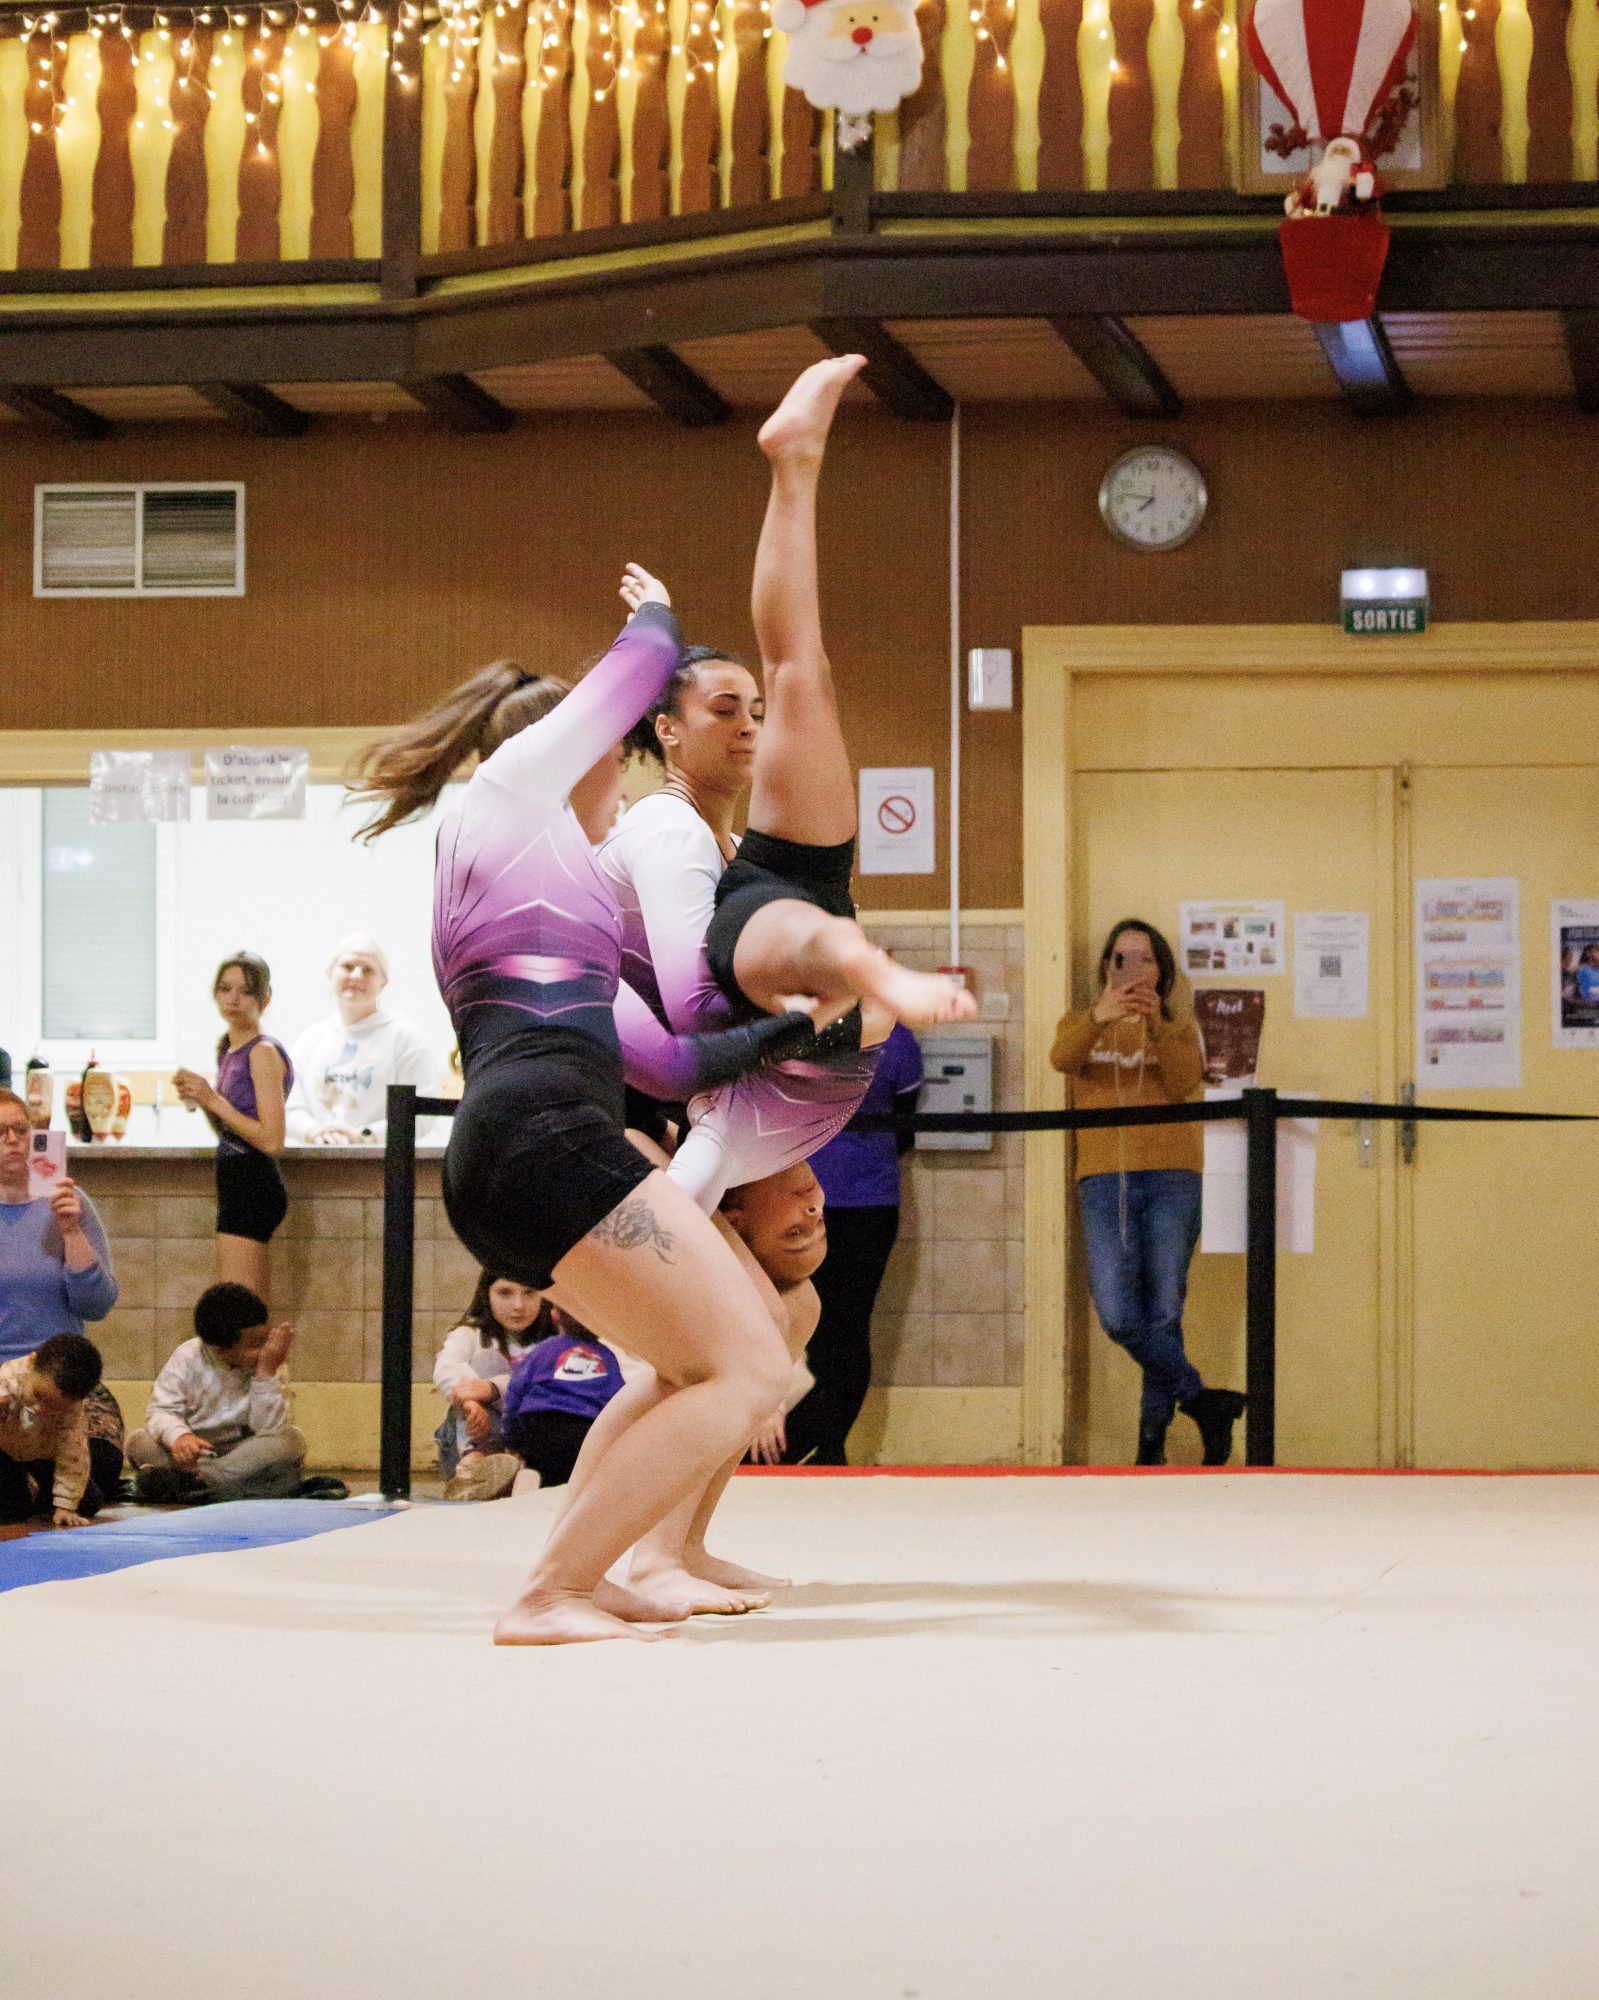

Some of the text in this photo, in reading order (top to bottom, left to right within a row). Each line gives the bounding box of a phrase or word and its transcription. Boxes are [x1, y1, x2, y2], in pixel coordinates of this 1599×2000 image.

[1353, 609, 1416, 630] SORTIE
[278, 753, 290, 763] le
[211, 774, 250, 787] ticket,
[217, 793, 228, 804] la
